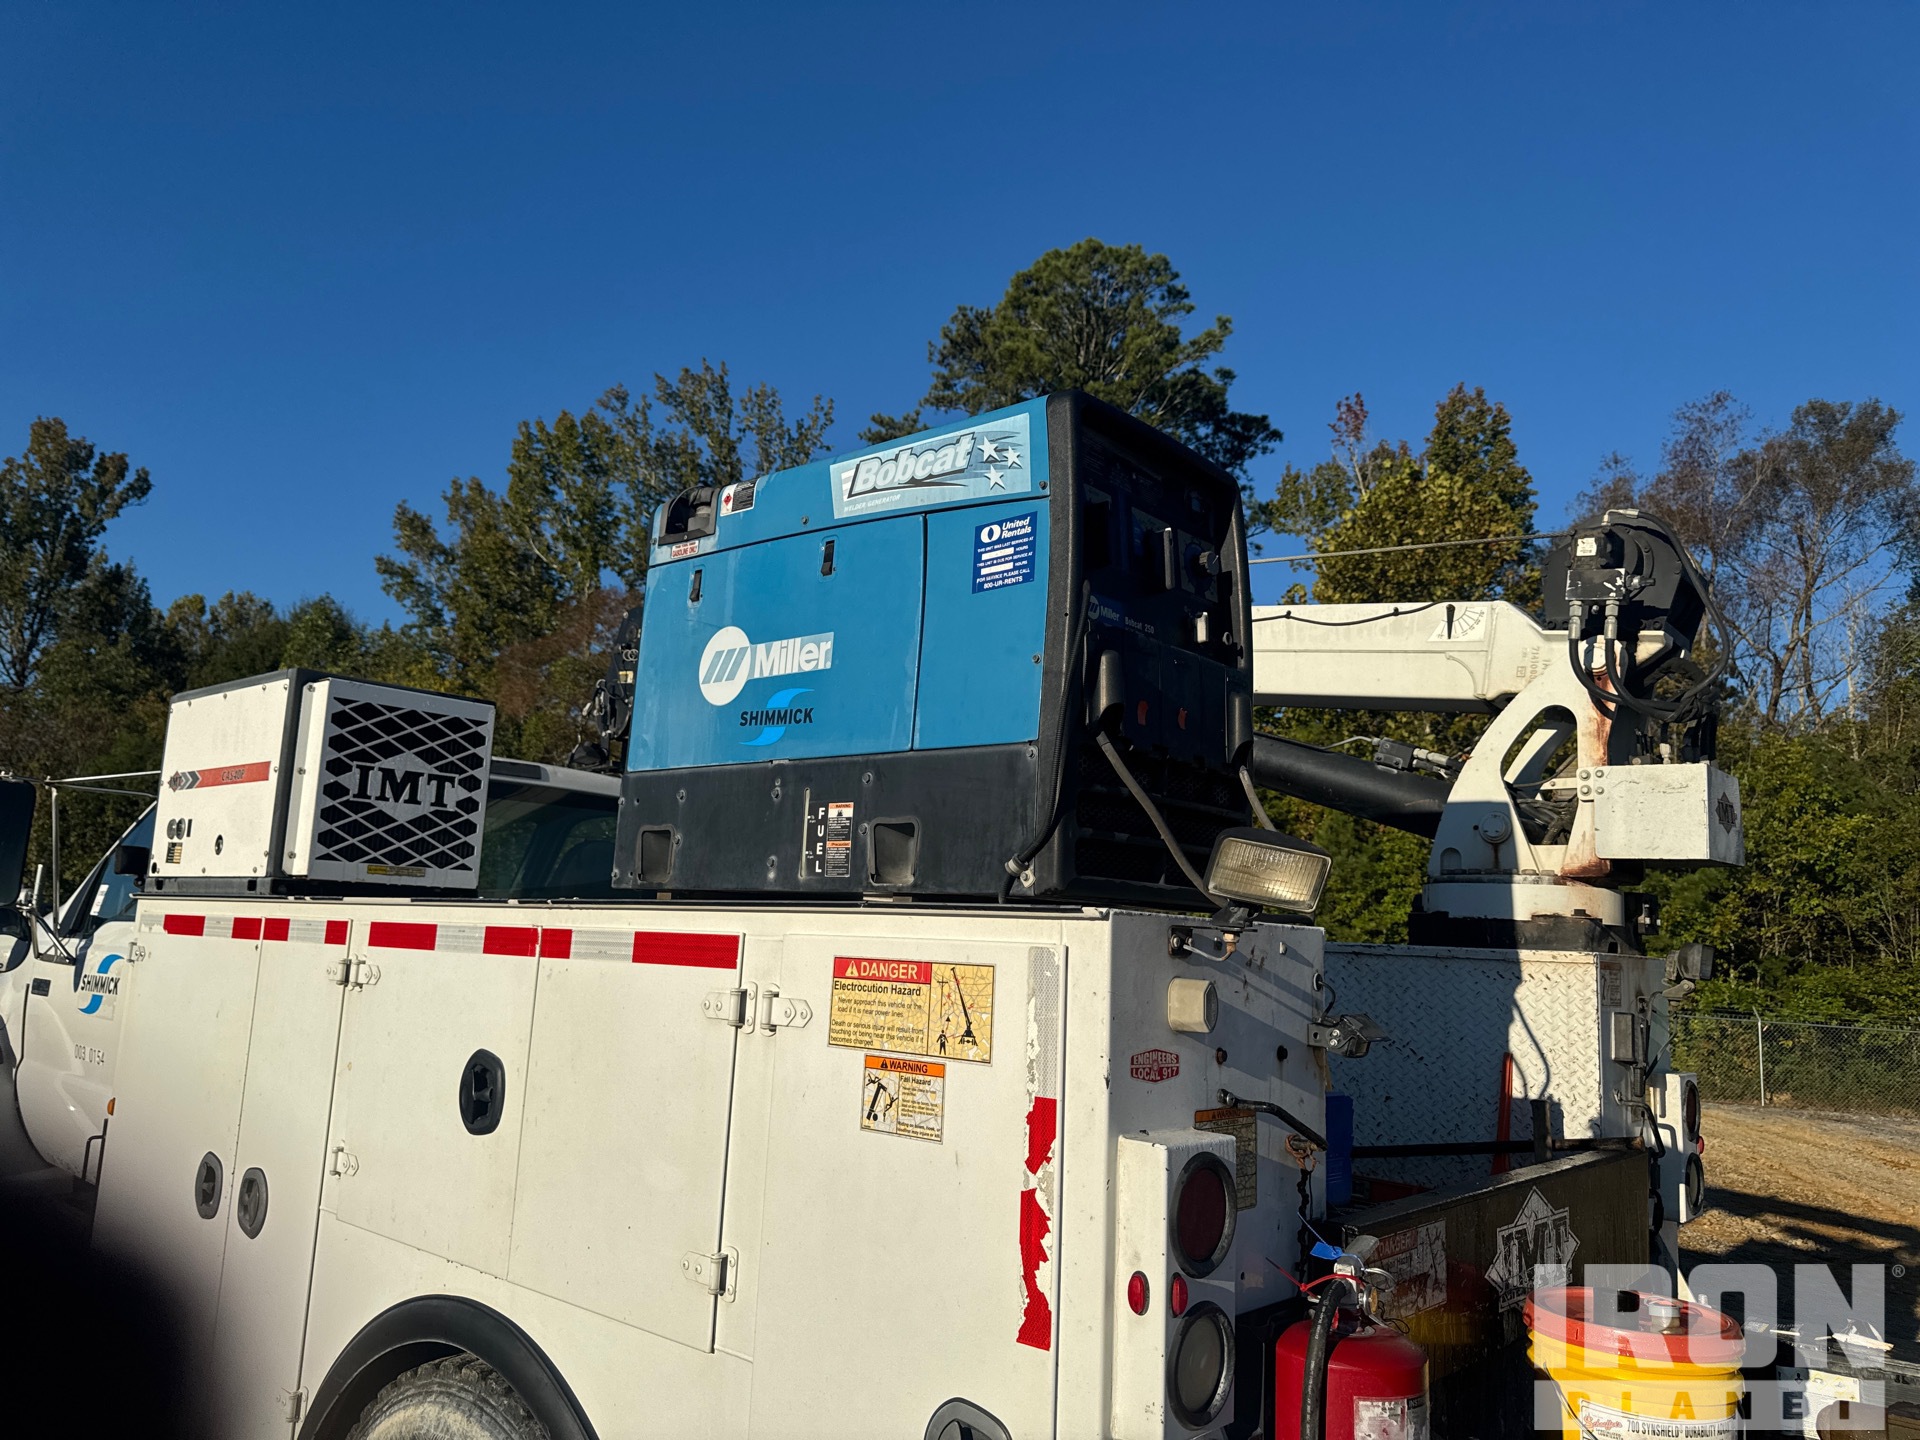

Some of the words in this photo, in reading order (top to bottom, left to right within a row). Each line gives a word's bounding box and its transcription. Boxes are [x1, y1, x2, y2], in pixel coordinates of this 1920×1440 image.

[849, 433, 975, 497] Bobcat
[844, 503, 865, 512] WELDER
[868, 494, 901, 506] GENERATOR
[1002, 516, 1031, 530] United
[1001, 526, 1032, 539] Rentals
[1101, 605, 1120, 621] Miller
[1125, 616, 1142, 630] Bobcat
[754, 638, 831, 678] Miller
[739, 708, 814, 727] SHIMMICK
[353, 764, 456, 809] IMT
[1718, 799, 1736, 827] IMT
[860, 961, 918, 980] DANGER
[81, 974, 120, 995] SHIMMICK
[834, 980, 888, 994] Electrocution
[891, 984, 921, 996] Hazard
[837, 1005, 848, 1013] load
[838, 996, 853, 1004] Never
[853, 998, 876, 1006] approach
[831, 1018, 846, 1026] Death
[853, 1021, 871, 1029] serious
[872, 1023, 885, 1032] injury
[896, 1025, 911, 1033] result
[911, 1026, 923, 1035] from
[831, 1028, 851, 1036] touching
[858, 1030, 872, 1038] being
[896, 1034, 914, 1042] vehicle
[831, 1035, 852, 1043] becomes
[74, 1044, 86, 1061] 003
[89, 1048, 105, 1065] 0154
[1133, 1051, 1177, 1065] ENGINEERS
[889, 1060, 928, 1074] WARNING
[1132, 1067, 1160, 1080] LOCAL
[1162, 1067, 1178, 1079] 917
[900, 1075, 910, 1083] Fall
[911, 1077, 931, 1086] Hazard
[1379, 1230, 1411, 1257] DANGER
[1627, 1420, 1639, 1434] 700
[1685, 1424, 1716, 1438] DURABILITY
